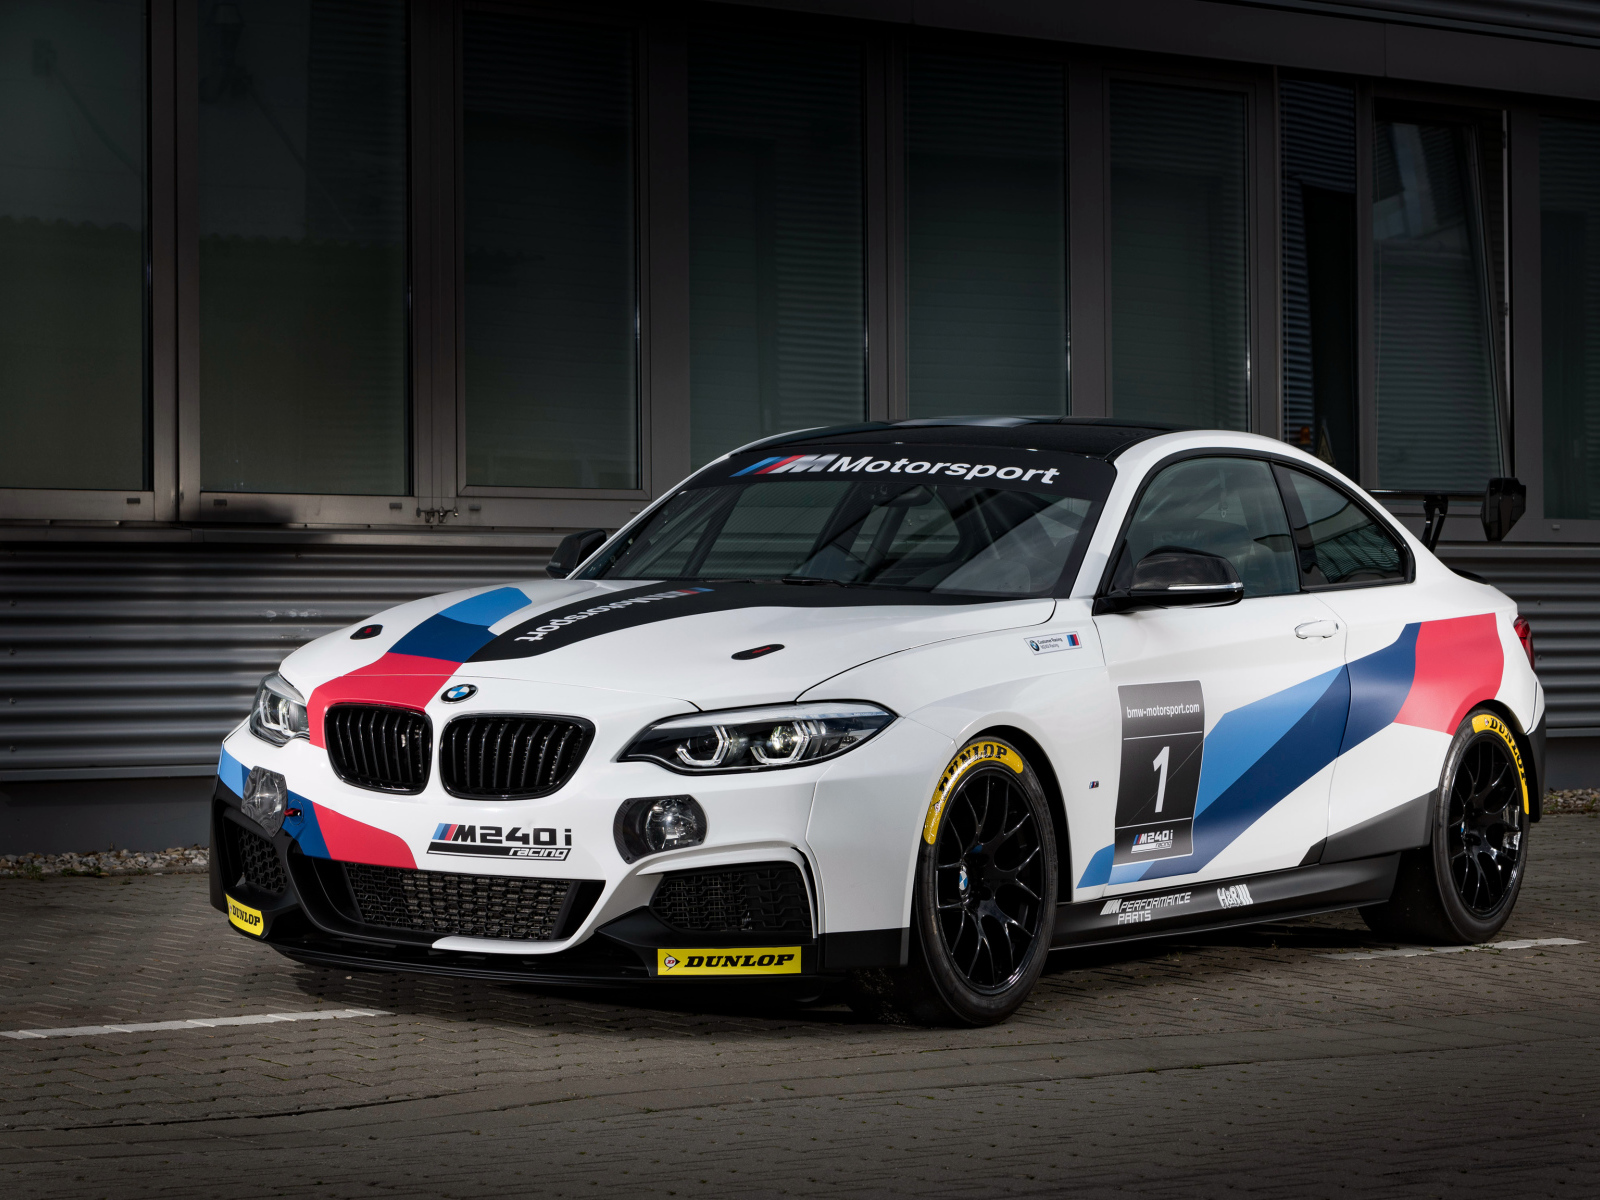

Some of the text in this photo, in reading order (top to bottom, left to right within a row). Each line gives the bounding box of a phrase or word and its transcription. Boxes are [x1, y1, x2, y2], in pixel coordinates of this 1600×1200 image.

[827, 456, 1060, 484] Motorsport
[514, 597, 664, 642] Motorsport
[1126, 703, 1200, 718] bmw-motorsport.com
[1152, 746, 1170, 813] 1
[508, 847, 569, 859] racing
[1119, 892, 1192, 912] PERFORMANCE
[232, 904, 261, 927] DUNLOP
[1117, 910, 1152, 925] PARTS
[684, 954, 795, 968] DUNLOP
